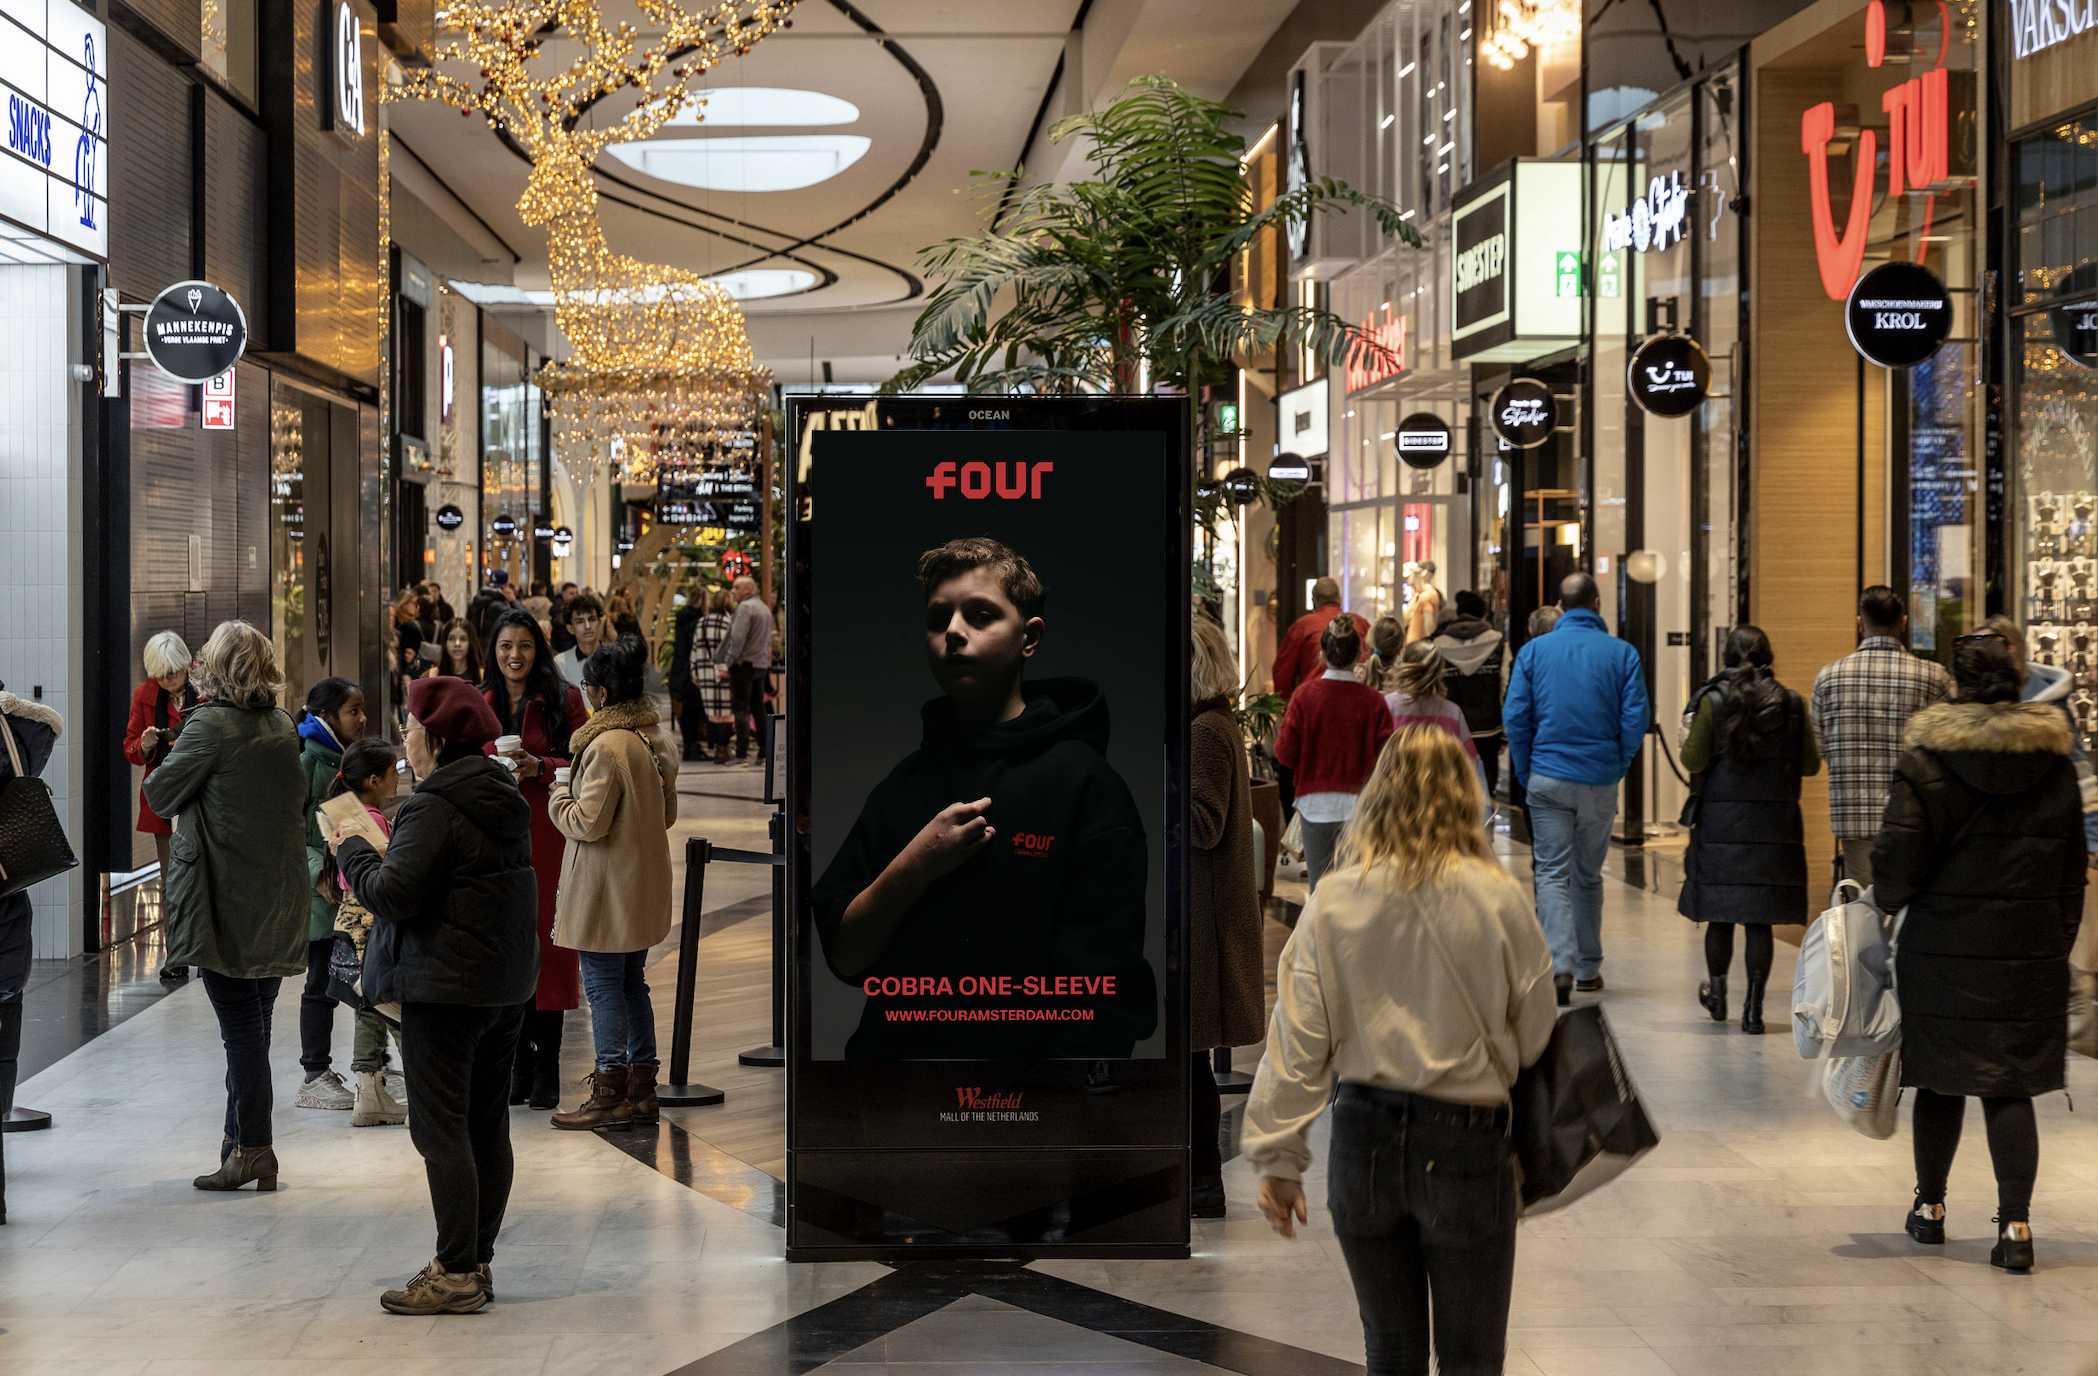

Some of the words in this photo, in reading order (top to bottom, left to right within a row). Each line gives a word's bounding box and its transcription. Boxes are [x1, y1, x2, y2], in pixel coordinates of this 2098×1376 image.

[9, 93, 51, 167] SNACKS
[1882, 67, 1948, 197] TUI
[1457, 233, 1504, 293] SIDESTEP
[156, 320, 234, 336] MANNEKENPIS
[1874, 312, 1928, 329] KROL
[1673, 370, 1694, 381] TUI
[968, 410, 1010, 420] OCEAN
[1501, 407, 1548, 427] Studio
[863, 976, 953, 996] COBRA
[958, 976, 1117, 996] ONE-SLEEVE
[885, 1009, 1095, 1021] WWW.FOURAMSTERDAM.COM
[956, 1086, 1023, 1109] Westfield
[940, 1112, 959, 1121] MALL
[960, 1112, 970, 1121] OF
[972, 1112, 985, 1121] THE
[986, 1112, 1039, 1121] NETHERLANDS
